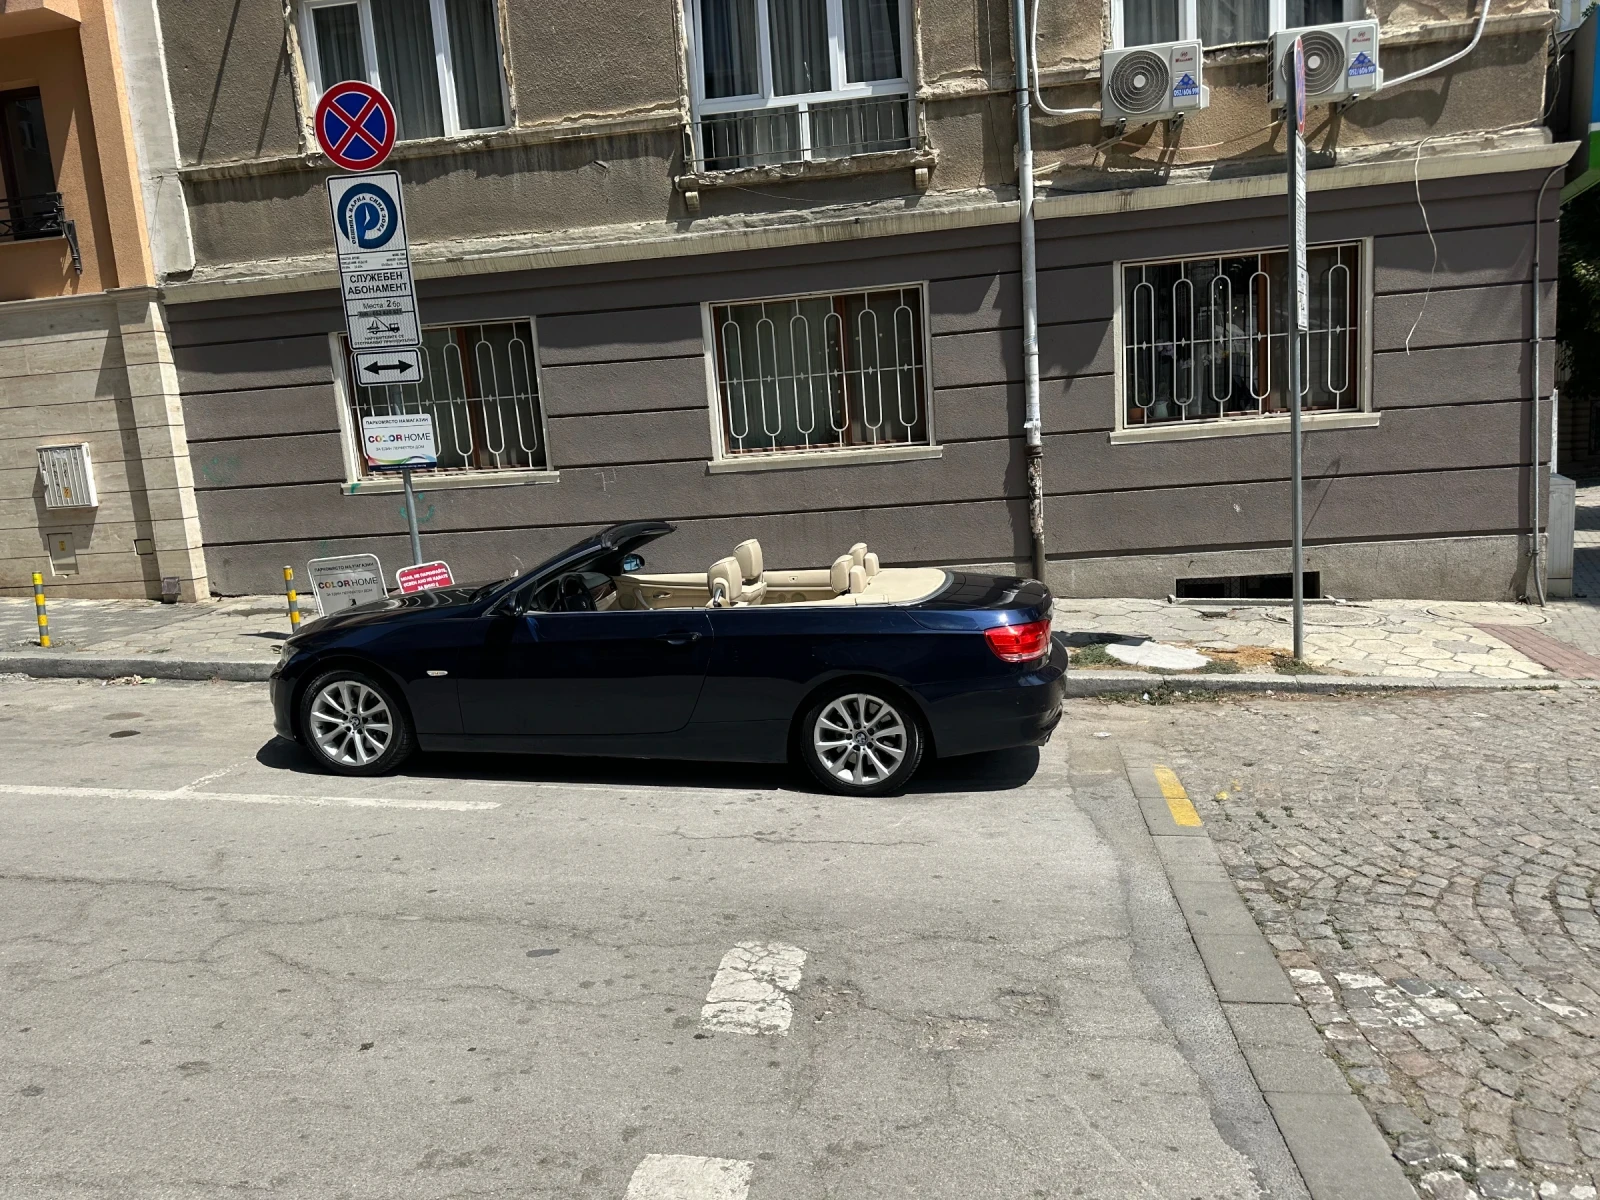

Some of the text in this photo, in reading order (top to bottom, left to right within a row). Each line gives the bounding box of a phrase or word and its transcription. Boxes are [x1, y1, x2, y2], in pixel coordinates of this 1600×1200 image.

[348, 195, 366, 213] ВАРНА
[369, 196, 387, 232] СИНЯ ЗОНА
[348, 215, 356, 245] ОБЩИНА
[350, 271, 403, 284] СЛУЖЕБЕН
[348, 282, 407, 295] АБОНАМЕНТ
[386, 300, 391, 308] 2
[368, 433, 431, 443] COLOR HOME
[318, 577, 379, 589] COLOR HOME
